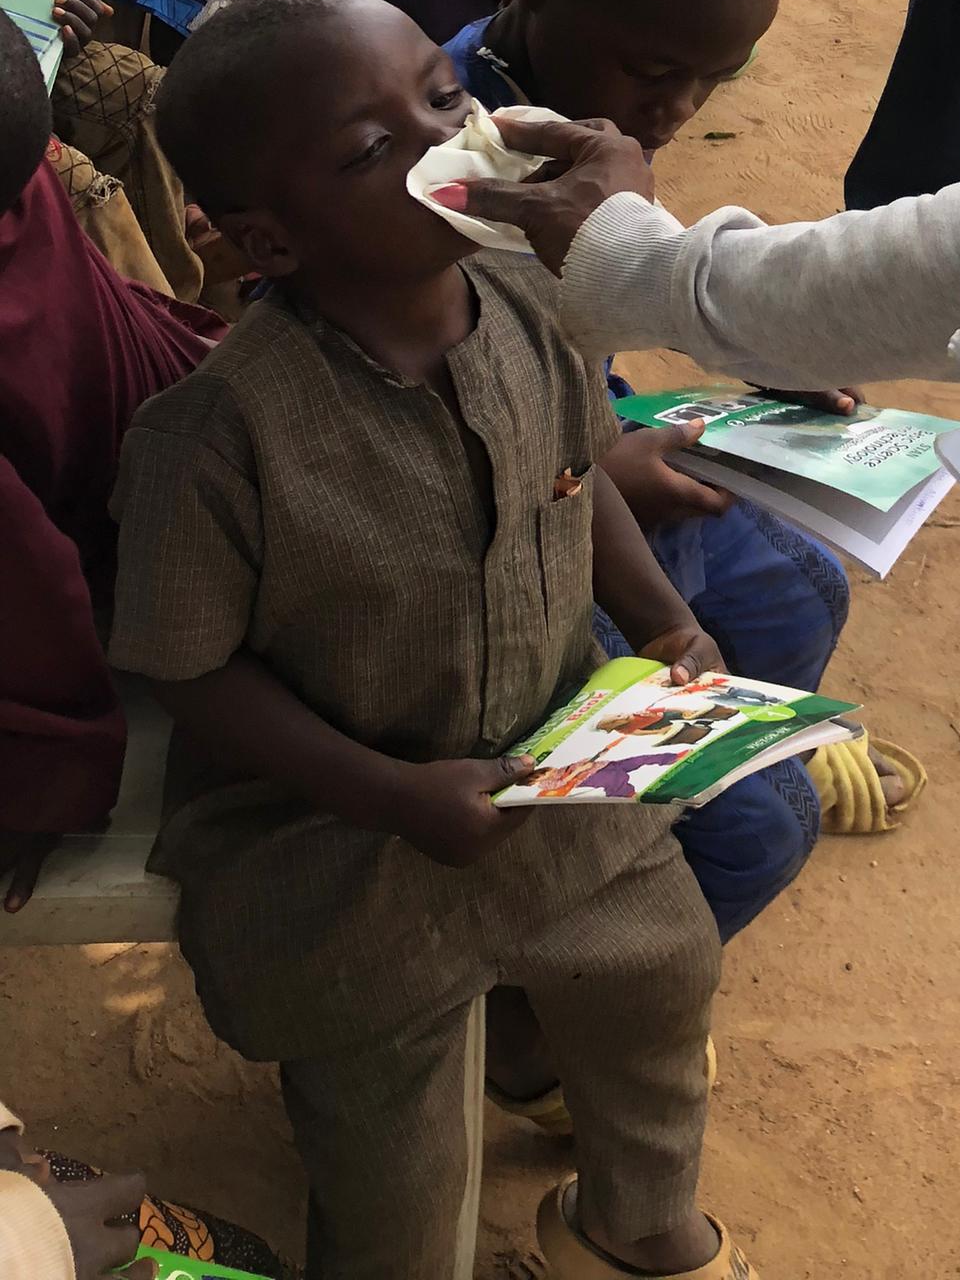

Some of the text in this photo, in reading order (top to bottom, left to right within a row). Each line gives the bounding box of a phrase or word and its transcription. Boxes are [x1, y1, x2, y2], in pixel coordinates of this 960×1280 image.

[841, 431, 903, 465] Technology
[863, 440, 904, 469] Science
[906, 442, 931, 459] STAN
